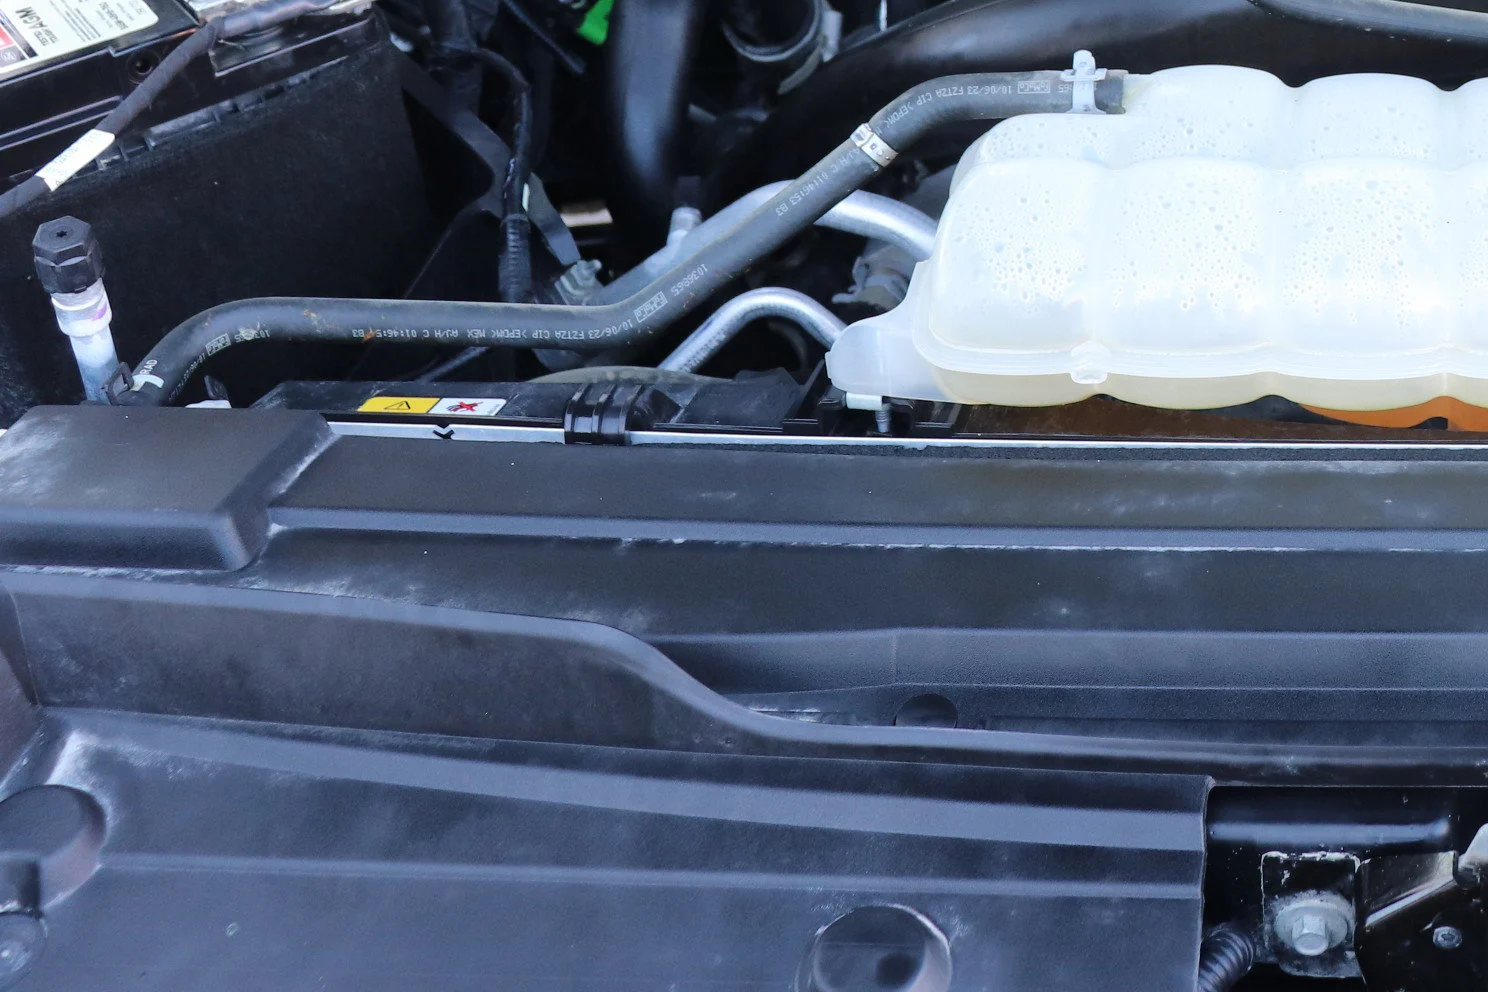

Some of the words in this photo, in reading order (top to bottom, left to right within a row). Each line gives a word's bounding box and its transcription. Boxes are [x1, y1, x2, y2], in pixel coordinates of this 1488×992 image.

[15, 6, 48, 29] AGM
[967, 85, 1012, 95] 10/06/23
[775, 201, 789, 217] B3
[670, 263, 708, 297] 1036865
[352, 329, 365, 338] B3
[370, 329, 417, 338] 01:46:5
[588, 318, 633, 339] 10/06/23
[139, 359, 158, 375] RAD
